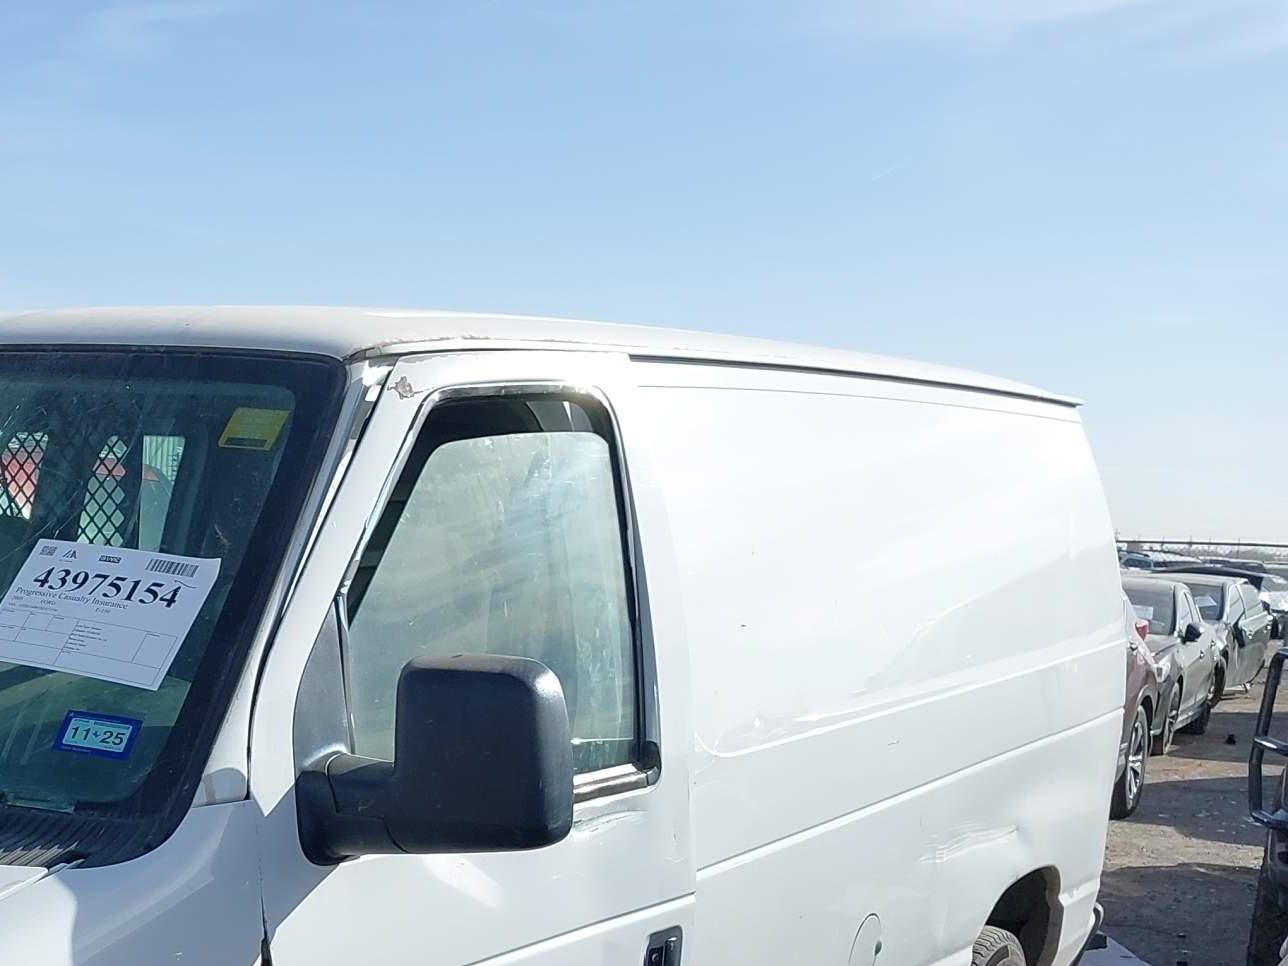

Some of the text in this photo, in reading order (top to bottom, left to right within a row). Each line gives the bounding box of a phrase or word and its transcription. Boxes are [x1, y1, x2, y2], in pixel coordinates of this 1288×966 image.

[15, 586, 58, 600] Progressive
[58, 592, 91, 605] Casualty
[91, 597, 129, 610] Insurance
[32, 566, 182, 608] 43975154
